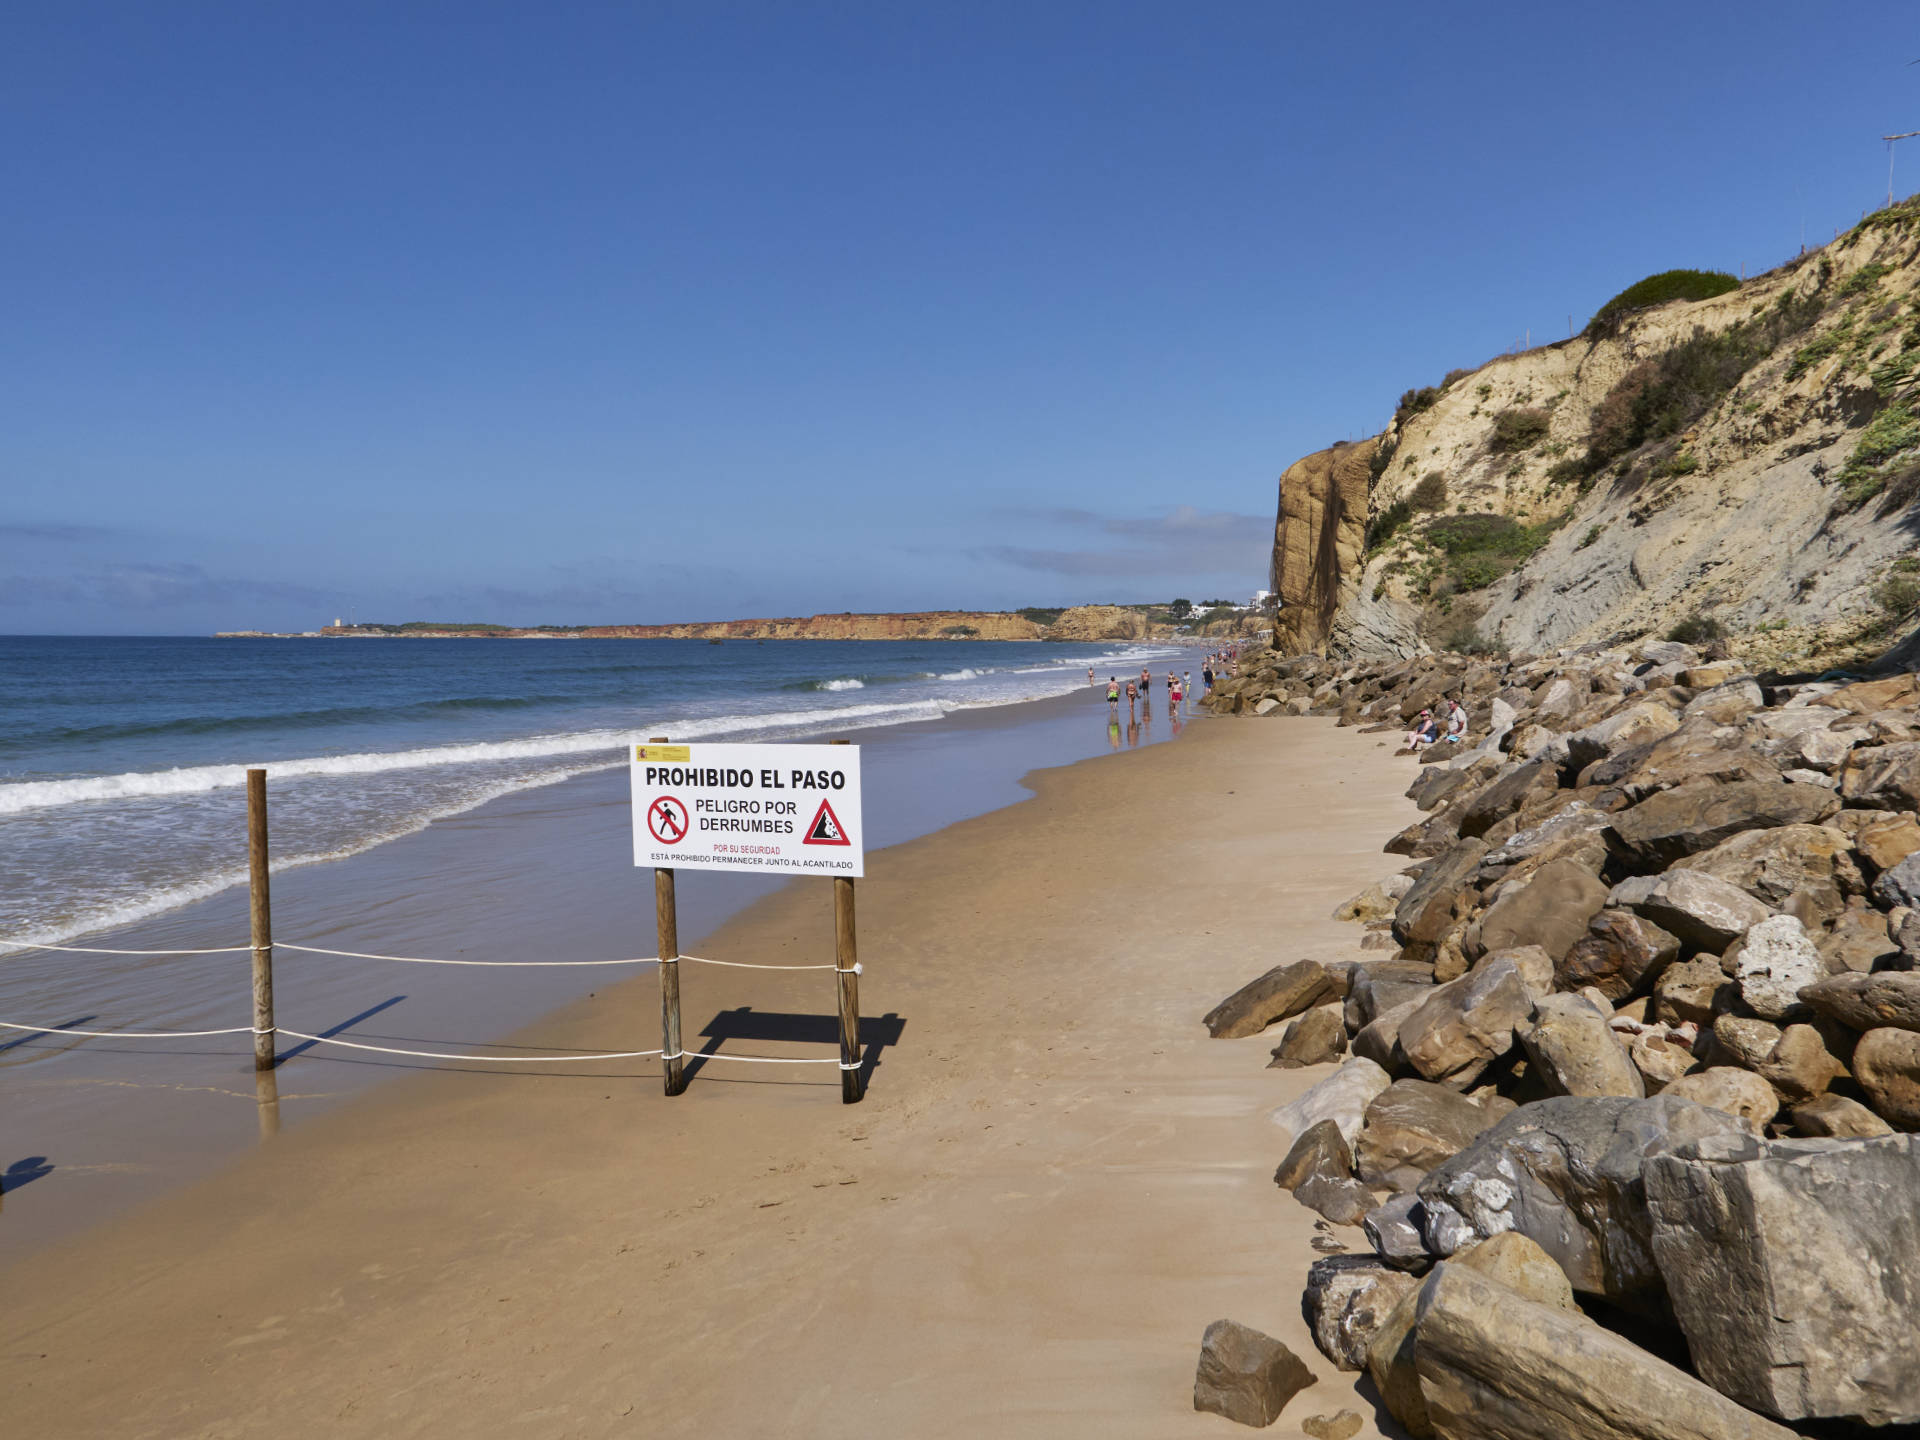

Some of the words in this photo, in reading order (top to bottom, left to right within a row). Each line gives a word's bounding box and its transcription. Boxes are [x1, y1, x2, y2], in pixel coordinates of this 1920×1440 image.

[646, 767, 754, 788] PROHIBIDO
[760, 769, 784, 789] EL
[791, 770, 845, 790] PASO
[696, 799, 760, 814] PELIGRO
[765, 801, 797, 815] POR
[700, 818, 793, 833] DERRUMBES
[713, 844, 728, 852] POR
[729, 845, 739, 853] SU
[740, 845, 780, 855] SEGURIDAD
[671, 854, 710, 863] PROHIBIDO
[712, 855, 763, 866] PERMANECER
[765, 858, 790, 866] JUNTO
[791, 859, 801, 867] AL
[803, 859, 853, 869] ACANTILADO
